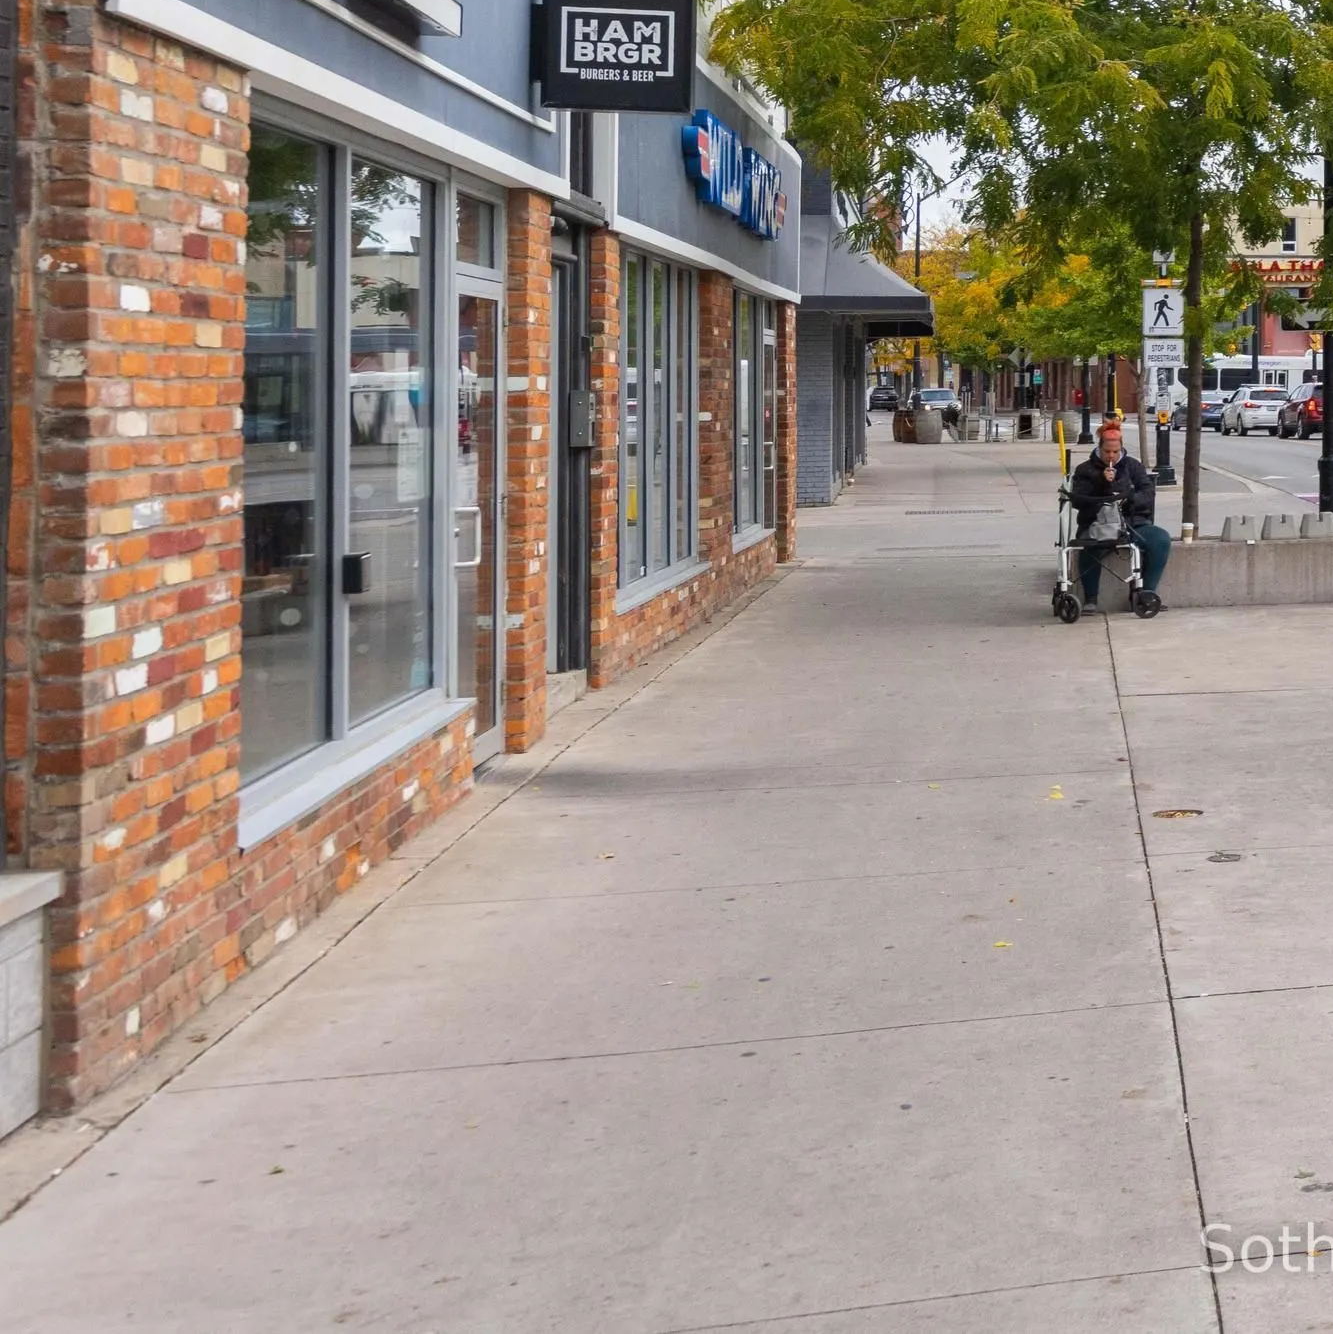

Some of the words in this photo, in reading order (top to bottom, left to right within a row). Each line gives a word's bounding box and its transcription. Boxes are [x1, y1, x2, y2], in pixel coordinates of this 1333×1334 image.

[574, 18, 662, 44] HAM
[573, 41, 662, 65] BRGR
[580, 68, 620, 81] BURGERS
[623, 69, 630, 81] &
[632, 70, 654, 82] BEER
[706, 115, 742, 216] WILD
[1151, 344, 1165, 352] STOP
[1167, 344, 1177, 352] FOR
[1147, 354, 1181, 363] PEDESTRIANS
